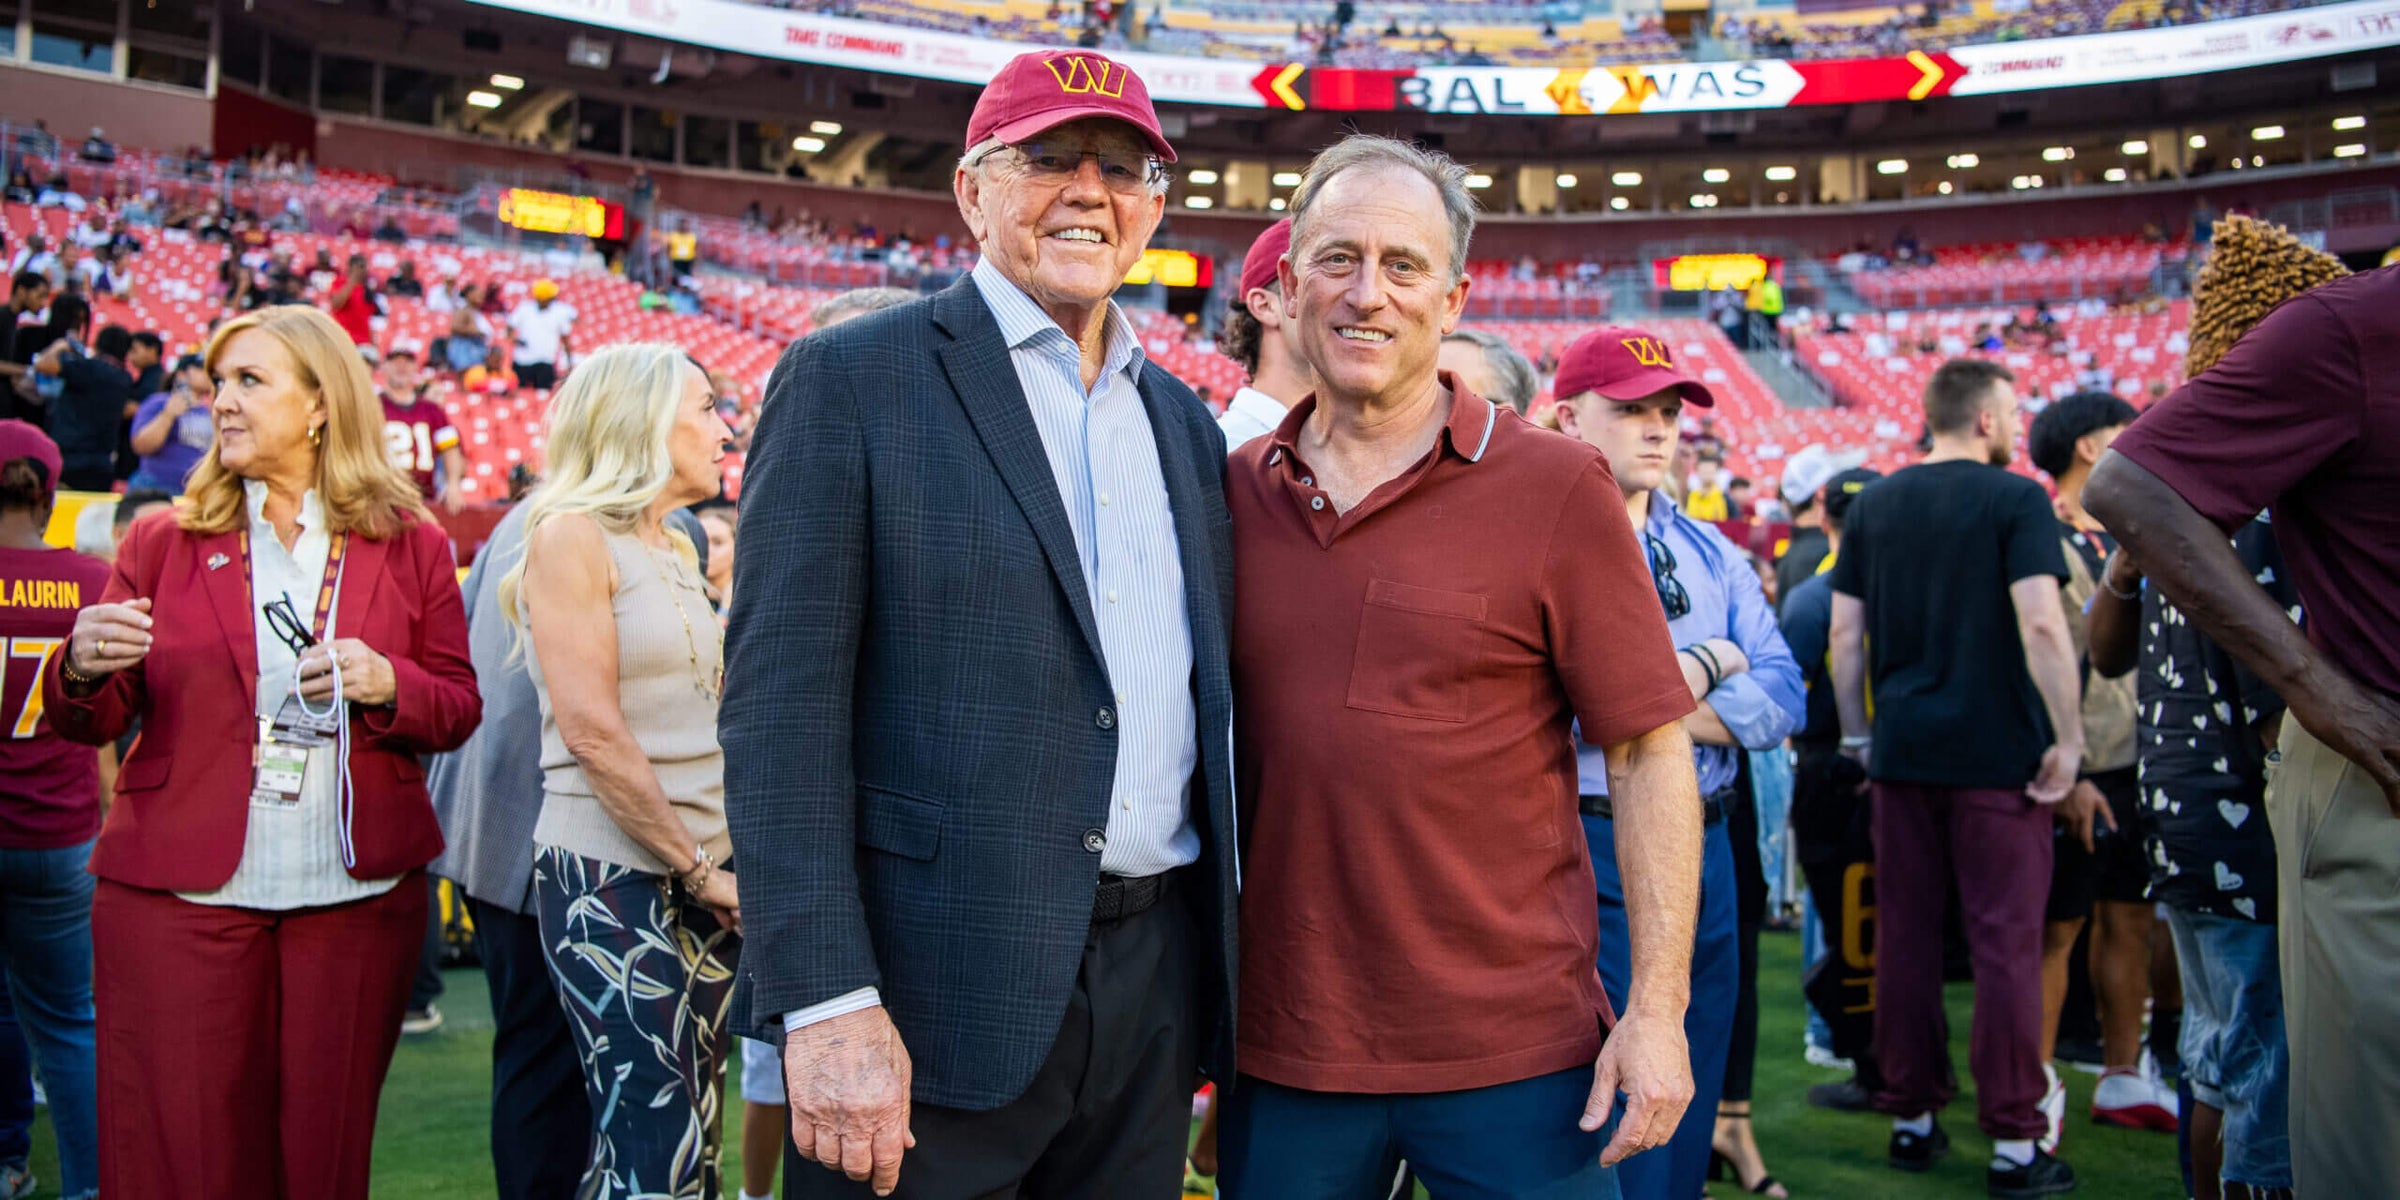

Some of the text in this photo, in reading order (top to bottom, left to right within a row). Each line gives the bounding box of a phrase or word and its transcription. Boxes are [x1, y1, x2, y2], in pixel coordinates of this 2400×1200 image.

[1394, 76, 1526, 113] BAL
[1621, 64, 1766, 101] WAS
[383, 420, 434, 470] 21
